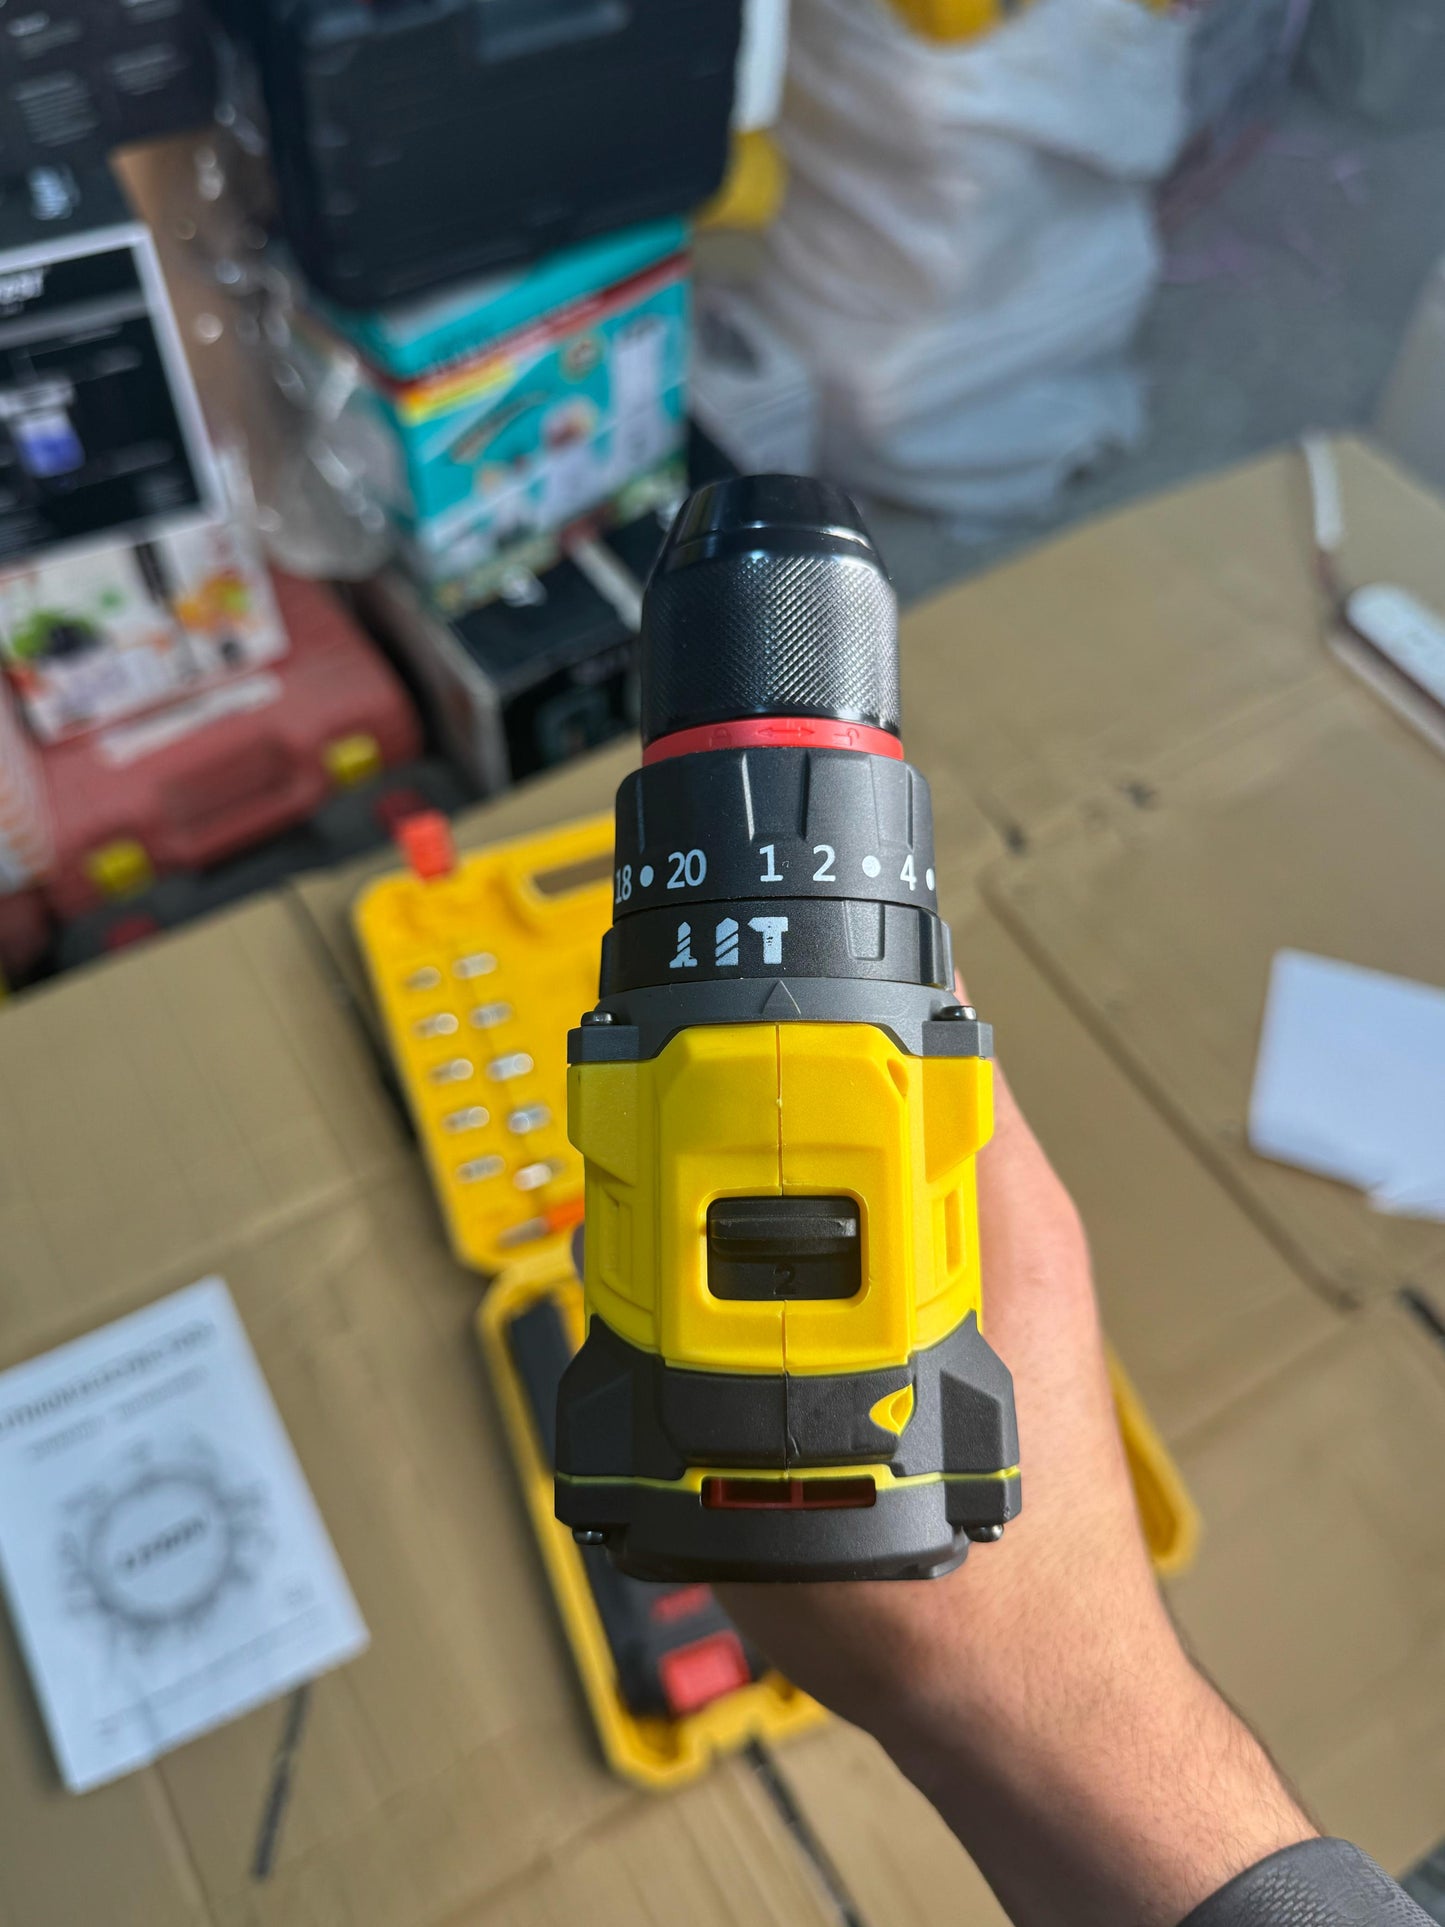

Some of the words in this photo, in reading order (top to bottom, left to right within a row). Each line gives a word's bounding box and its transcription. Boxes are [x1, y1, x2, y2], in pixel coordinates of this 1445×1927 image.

[615, 864, 632, 904] 18
[667, 849, 707, 889] 20
[759, 844, 784, 883] 1
[812, 844, 836, 882] 2
[900, 854, 918, 891] 4
[773, 1263, 798, 1296] 2
